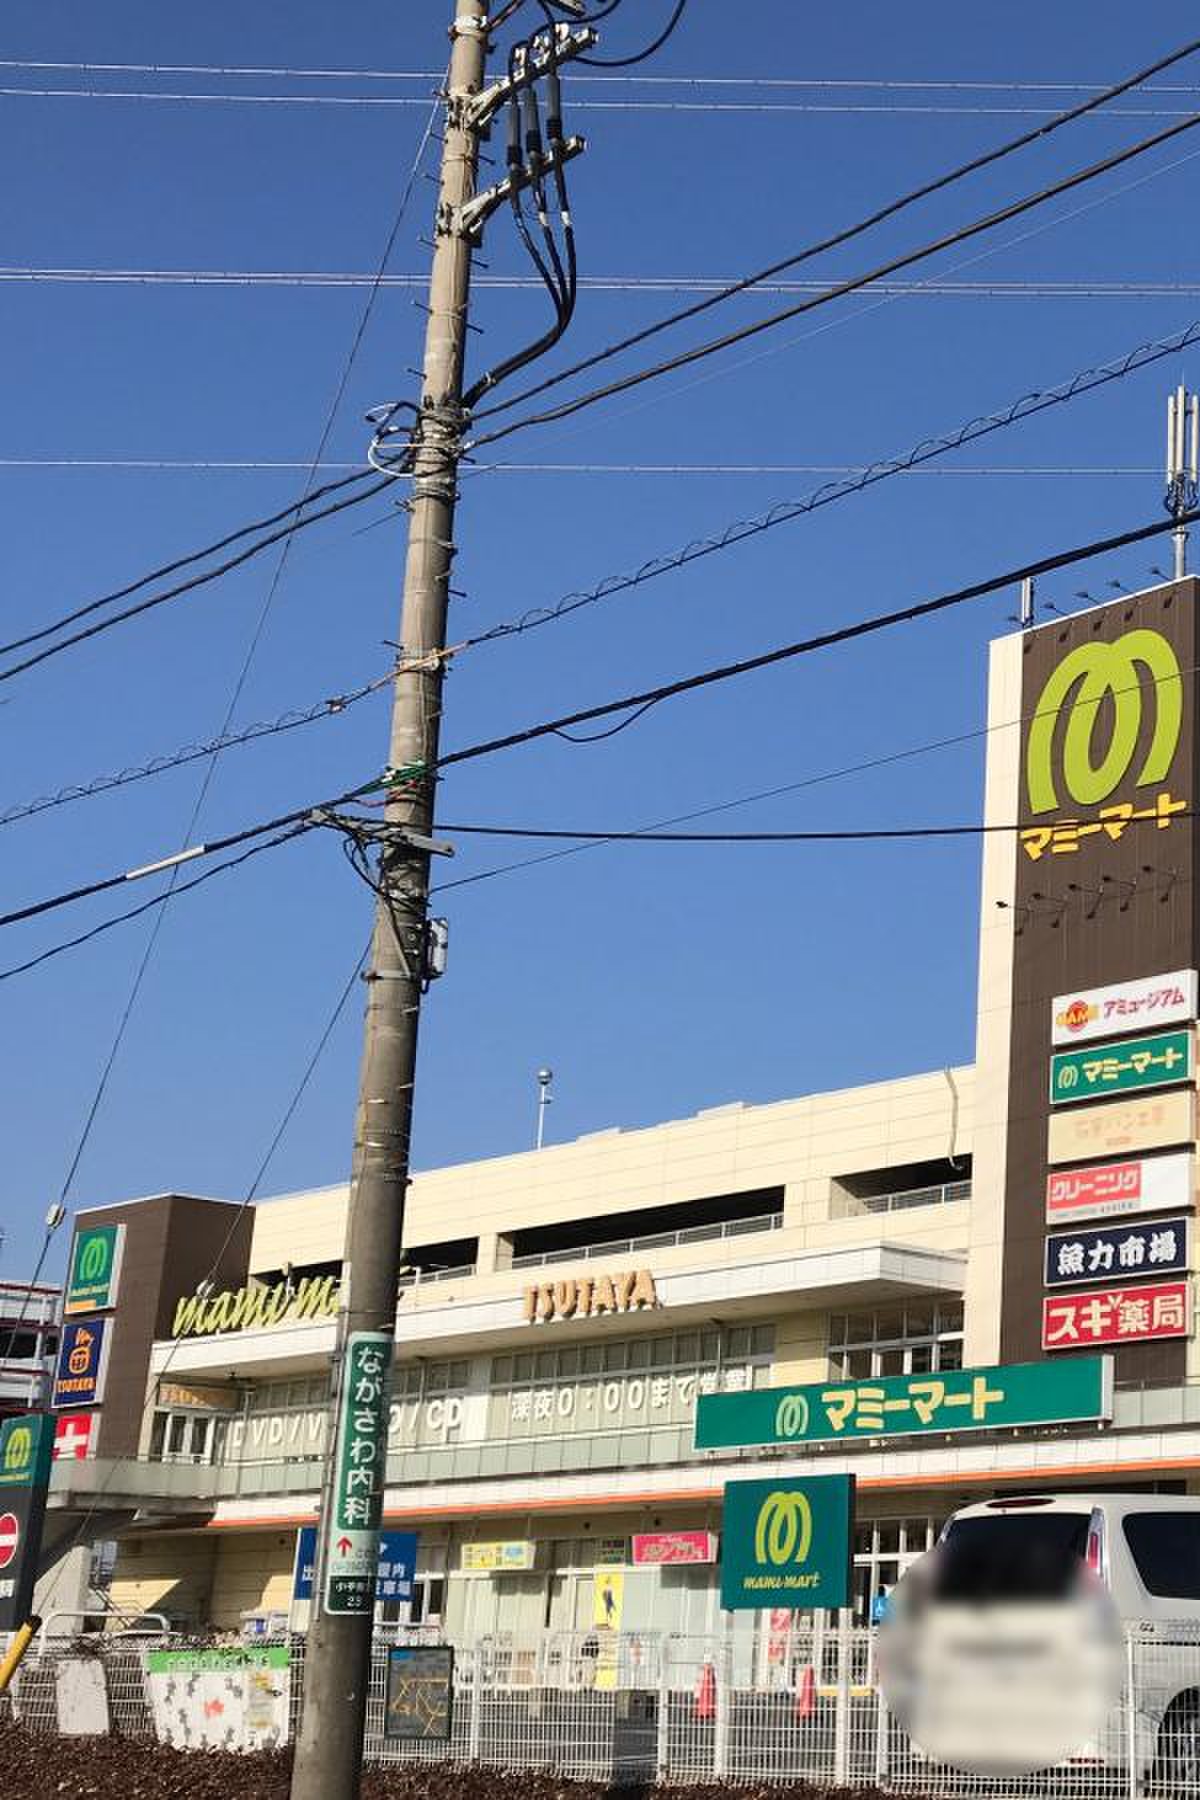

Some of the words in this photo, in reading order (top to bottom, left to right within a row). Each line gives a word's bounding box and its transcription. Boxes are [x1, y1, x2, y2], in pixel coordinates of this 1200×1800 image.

[1019, 793, 1187, 860] マミーマート
[1103, 986, 1185, 1020] アミュージアム
[1082, 1047, 1184, 1084] マミーマート
[1052, 1169, 1138, 1201] クリーニング
[1057, 1229, 1178, 1276] 魚力市場
[523, 1269, 656, 1321] TSUTAYA
[1047, 1294, 1184, 1341] スギ薬局
[821, 1376, 1006, 1432] マミーマート
[342, 1346, 385, 1526] ながさわ内科
